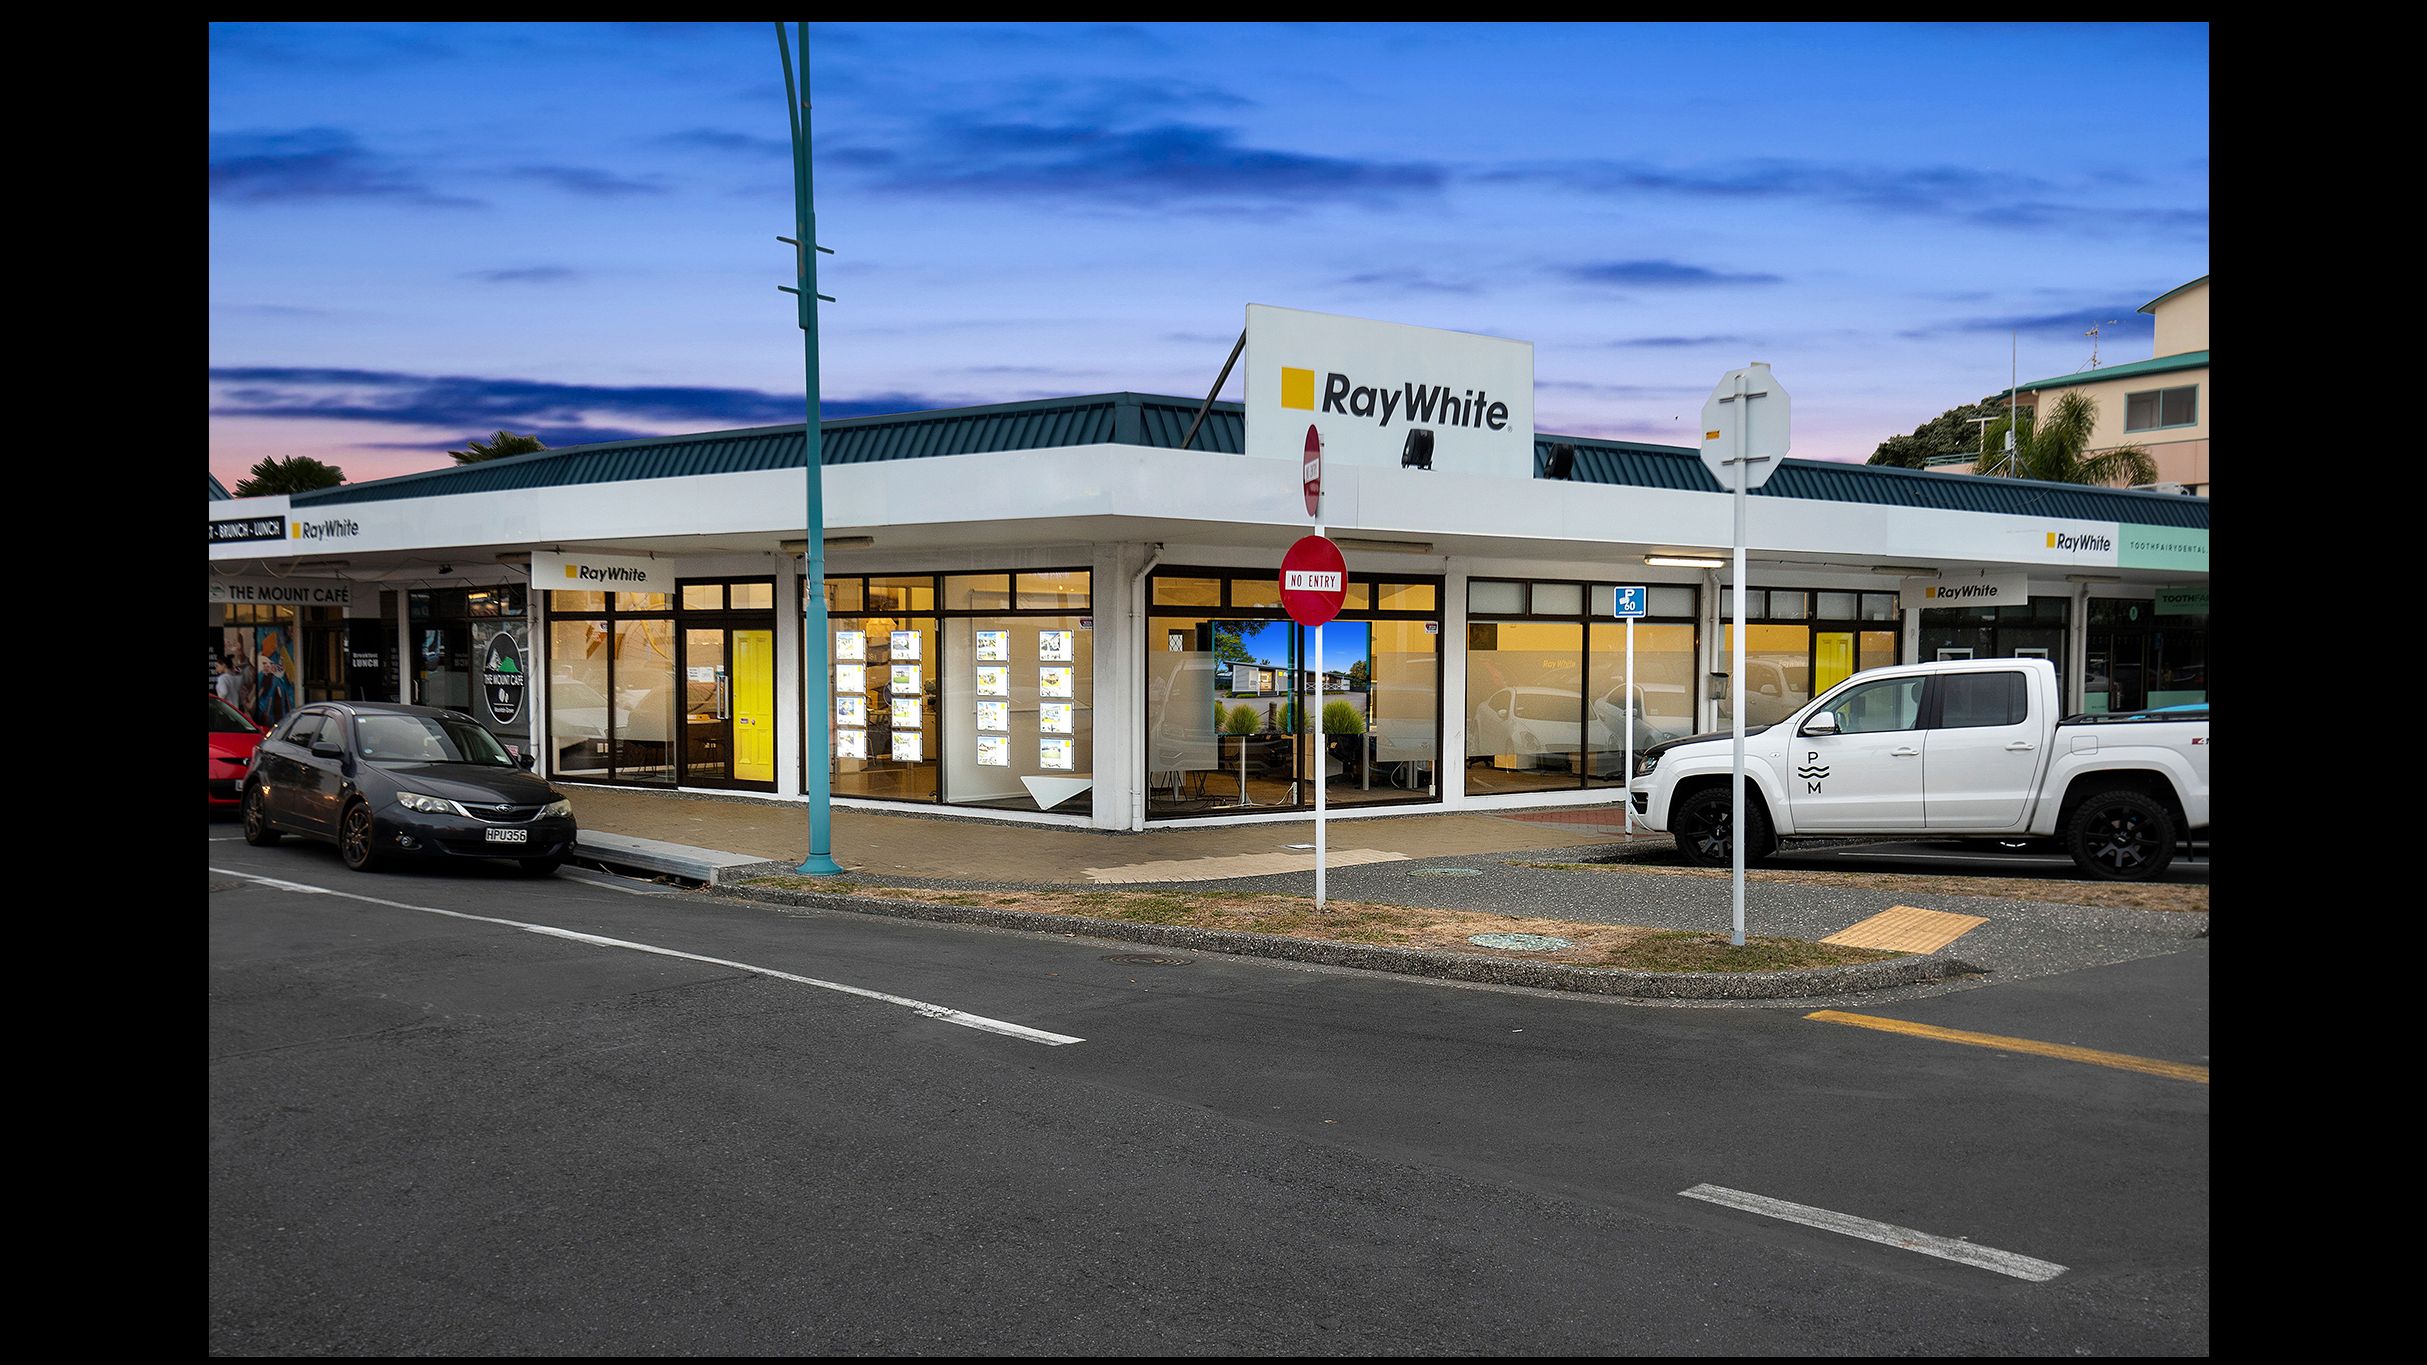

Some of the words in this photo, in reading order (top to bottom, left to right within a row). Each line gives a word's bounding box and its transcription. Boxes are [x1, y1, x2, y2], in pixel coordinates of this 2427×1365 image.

[218, 523, 249, 538] BRUNCH
[253, 520, 280, 536] LUNCH
[303, 519, 359, 541] RayWhite
[2057, 533, 2111, 553] RayWhite
[580, 565, 647, 582] RayWhite
[1291, 574, 1302, 587] NO
[1308, 574, 1336, 588] ENTRY
[229, 585, 254, 600] THE
[258, 586, 309, 601] MOUNT
[313, 586, 349, 602] CAFÉ
[1625, 589, 1635, 600] P
[1937, 584, 1998, 600] RayWhite
[1624, 601, 1636, 611] 60
[353, 659, 379, 668] LUNCH
[493, 674, 510, 686] MOUNT
[1808, 751, 1819, 764] P
[1807, 781, 1821, 794] M
[486, 829, 526, 841] HPU356
